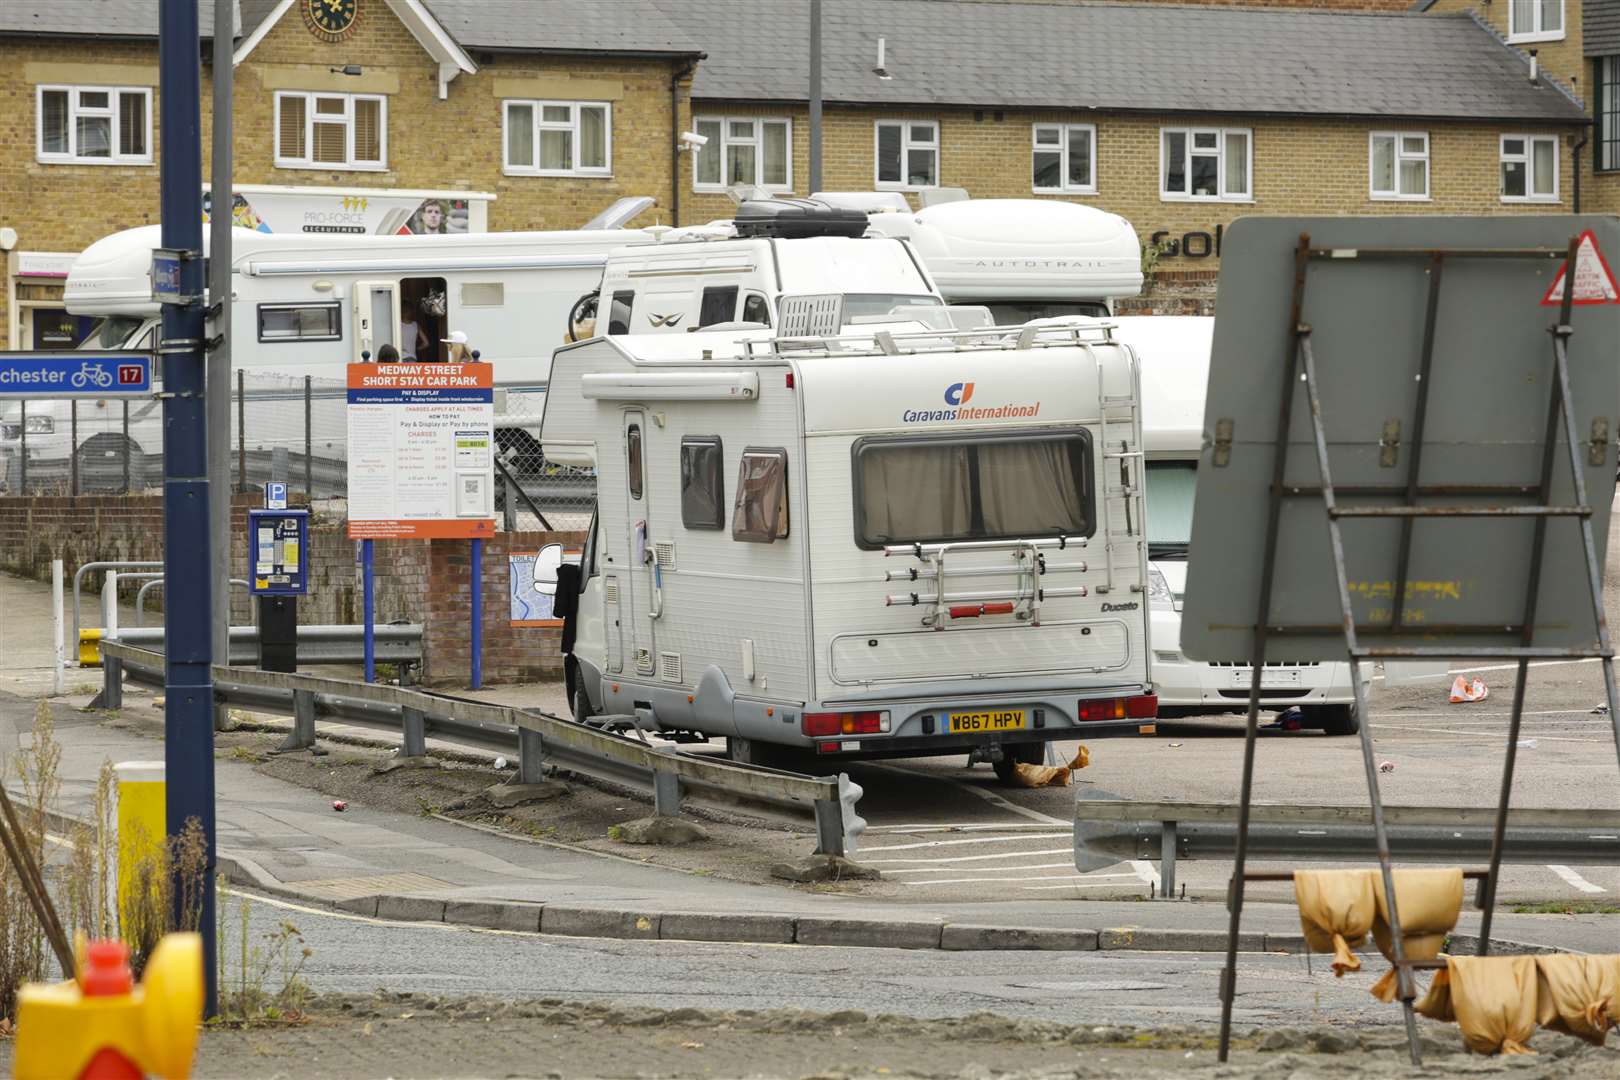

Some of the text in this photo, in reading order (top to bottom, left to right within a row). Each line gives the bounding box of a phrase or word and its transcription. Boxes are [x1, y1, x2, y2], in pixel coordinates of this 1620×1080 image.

[304, 211, 364, 224] PRO-FORCE
[304, 225, 365, 233] RECRUITMENT
[0, 368, 139, 383] chester 17
[377, 366, 464, 375] MEDWAY STREET
[363, 377, 478, 386] SHORT STAY CAR PARK
[272, 484, 284, 500] P
[951, 711, 1022, 730] W867 HPV
